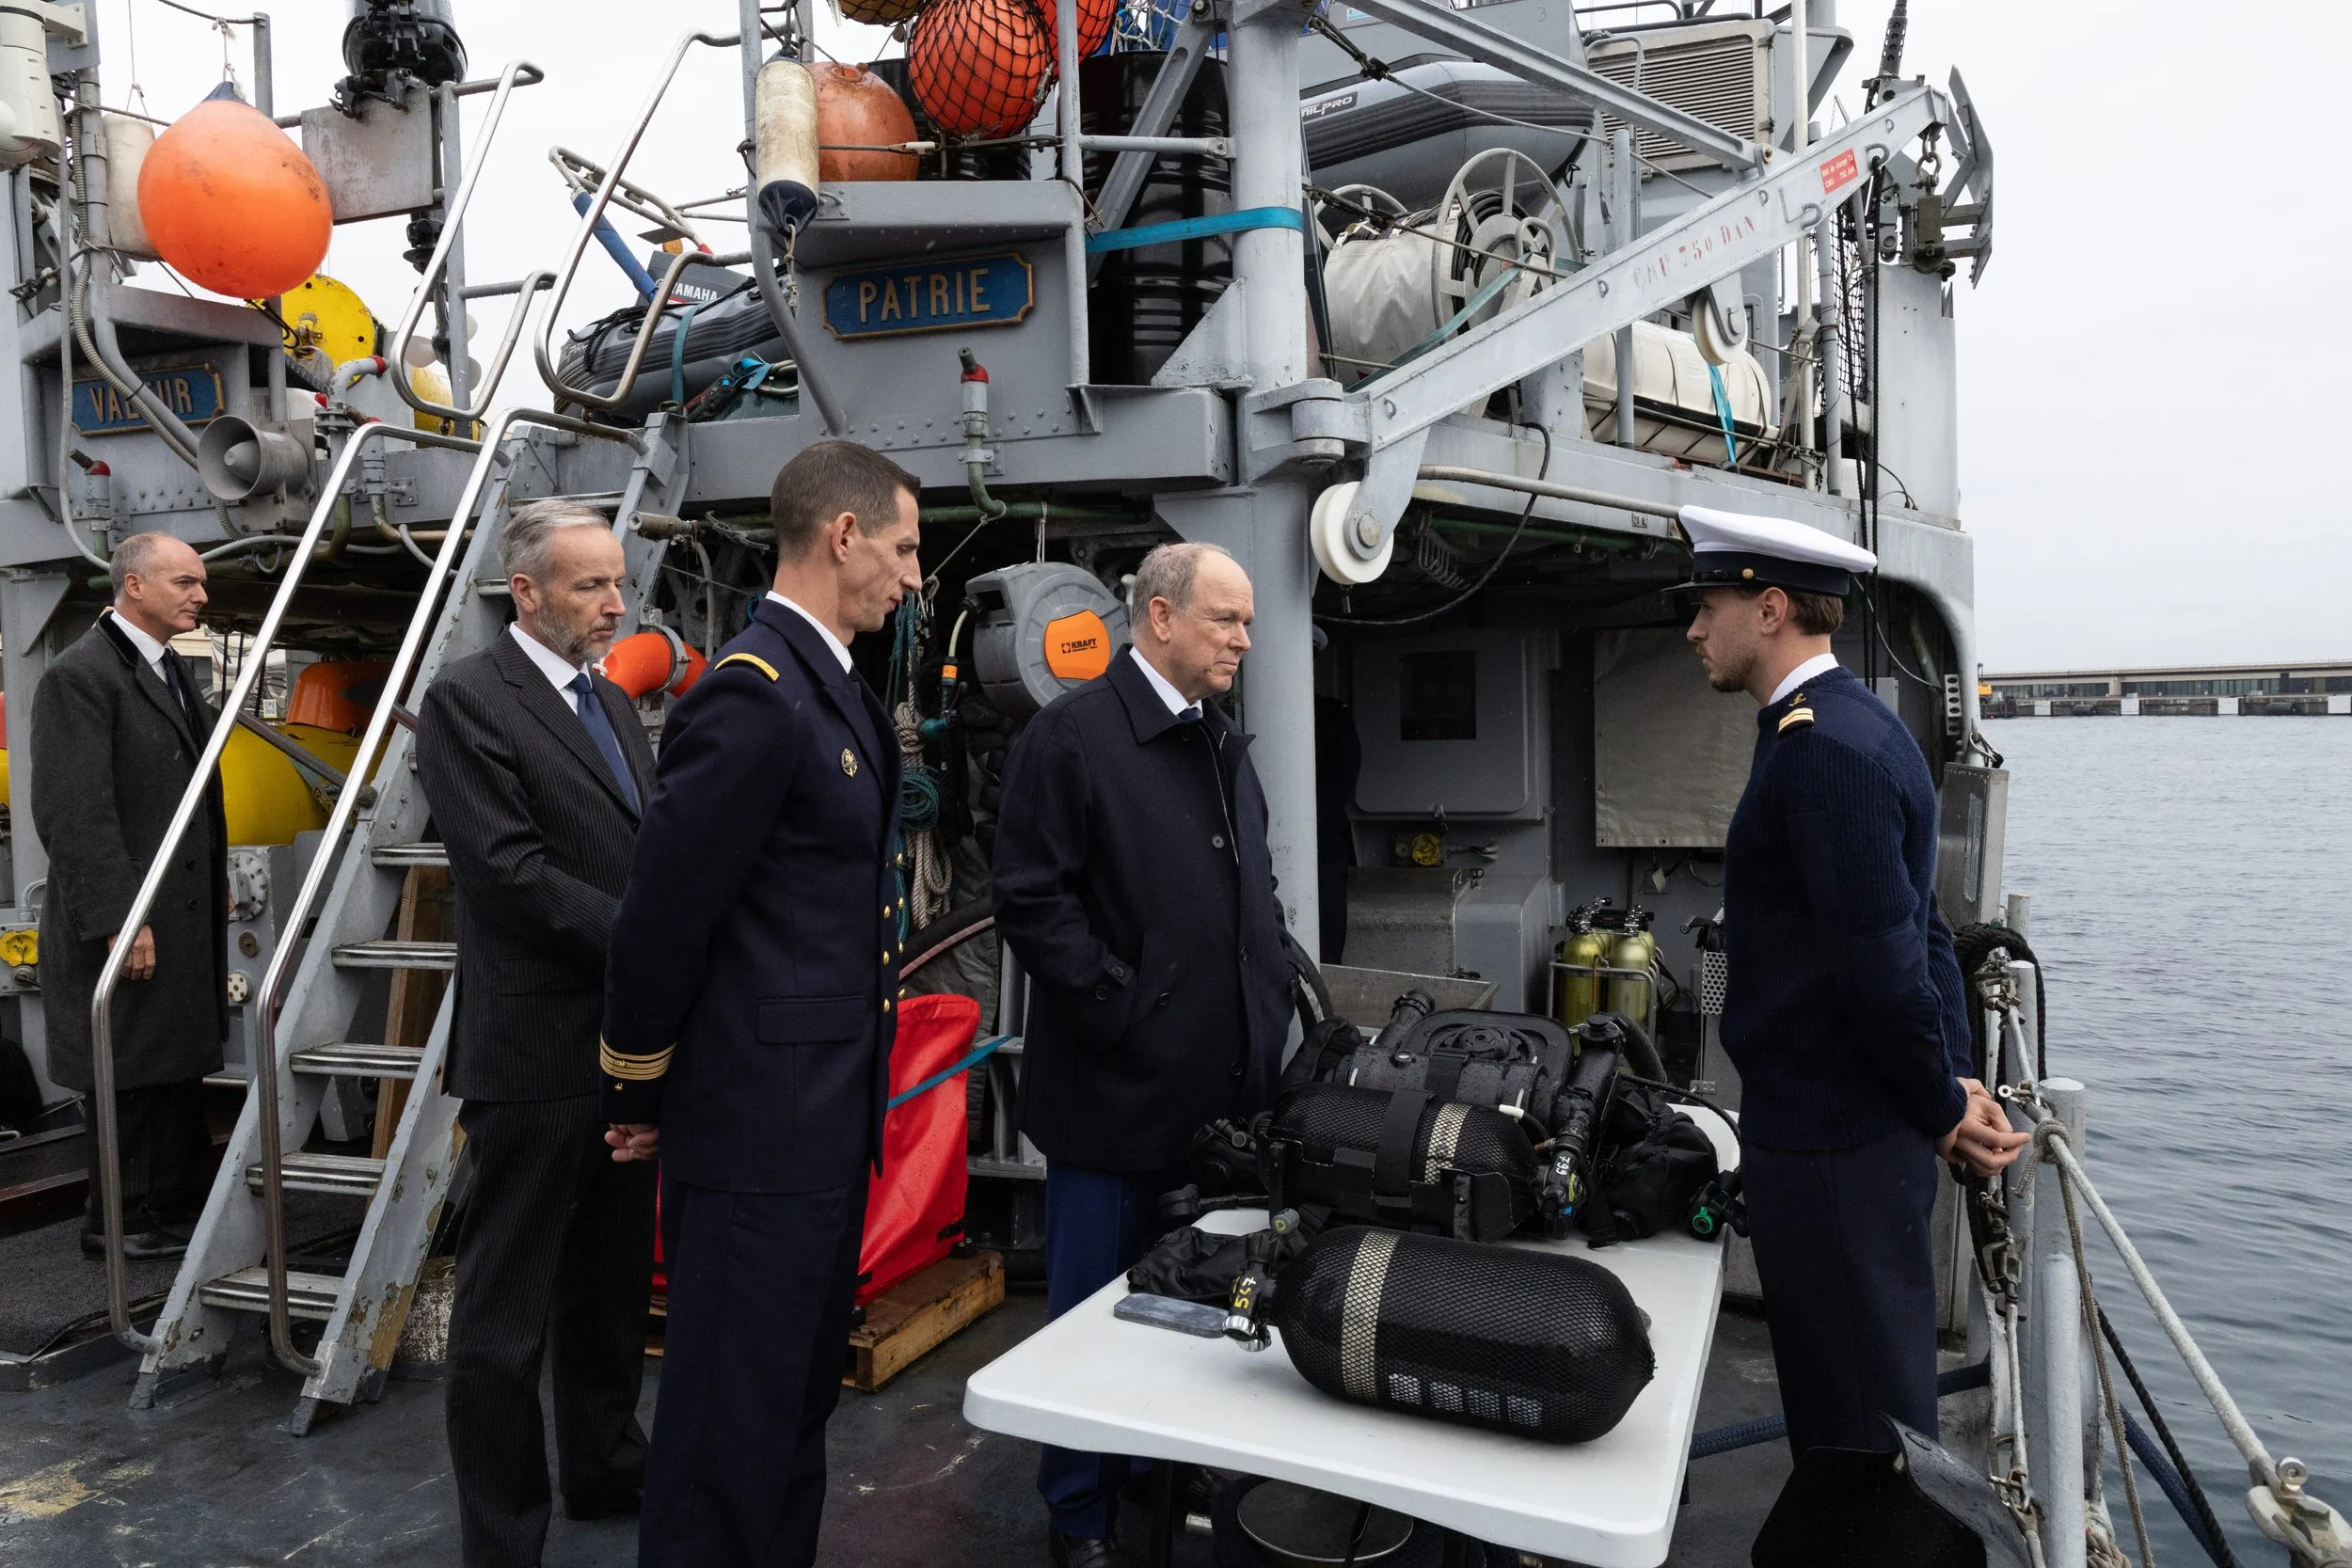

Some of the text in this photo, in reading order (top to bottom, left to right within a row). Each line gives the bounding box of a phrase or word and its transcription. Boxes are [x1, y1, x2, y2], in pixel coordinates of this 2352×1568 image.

[859, 268, 991, 324] PATRIE
[89, 377, 192, 422] VALUR
[1071, 638, 1096, 649] KRAFT
[1555, 1155, 1570, 1176] 799
